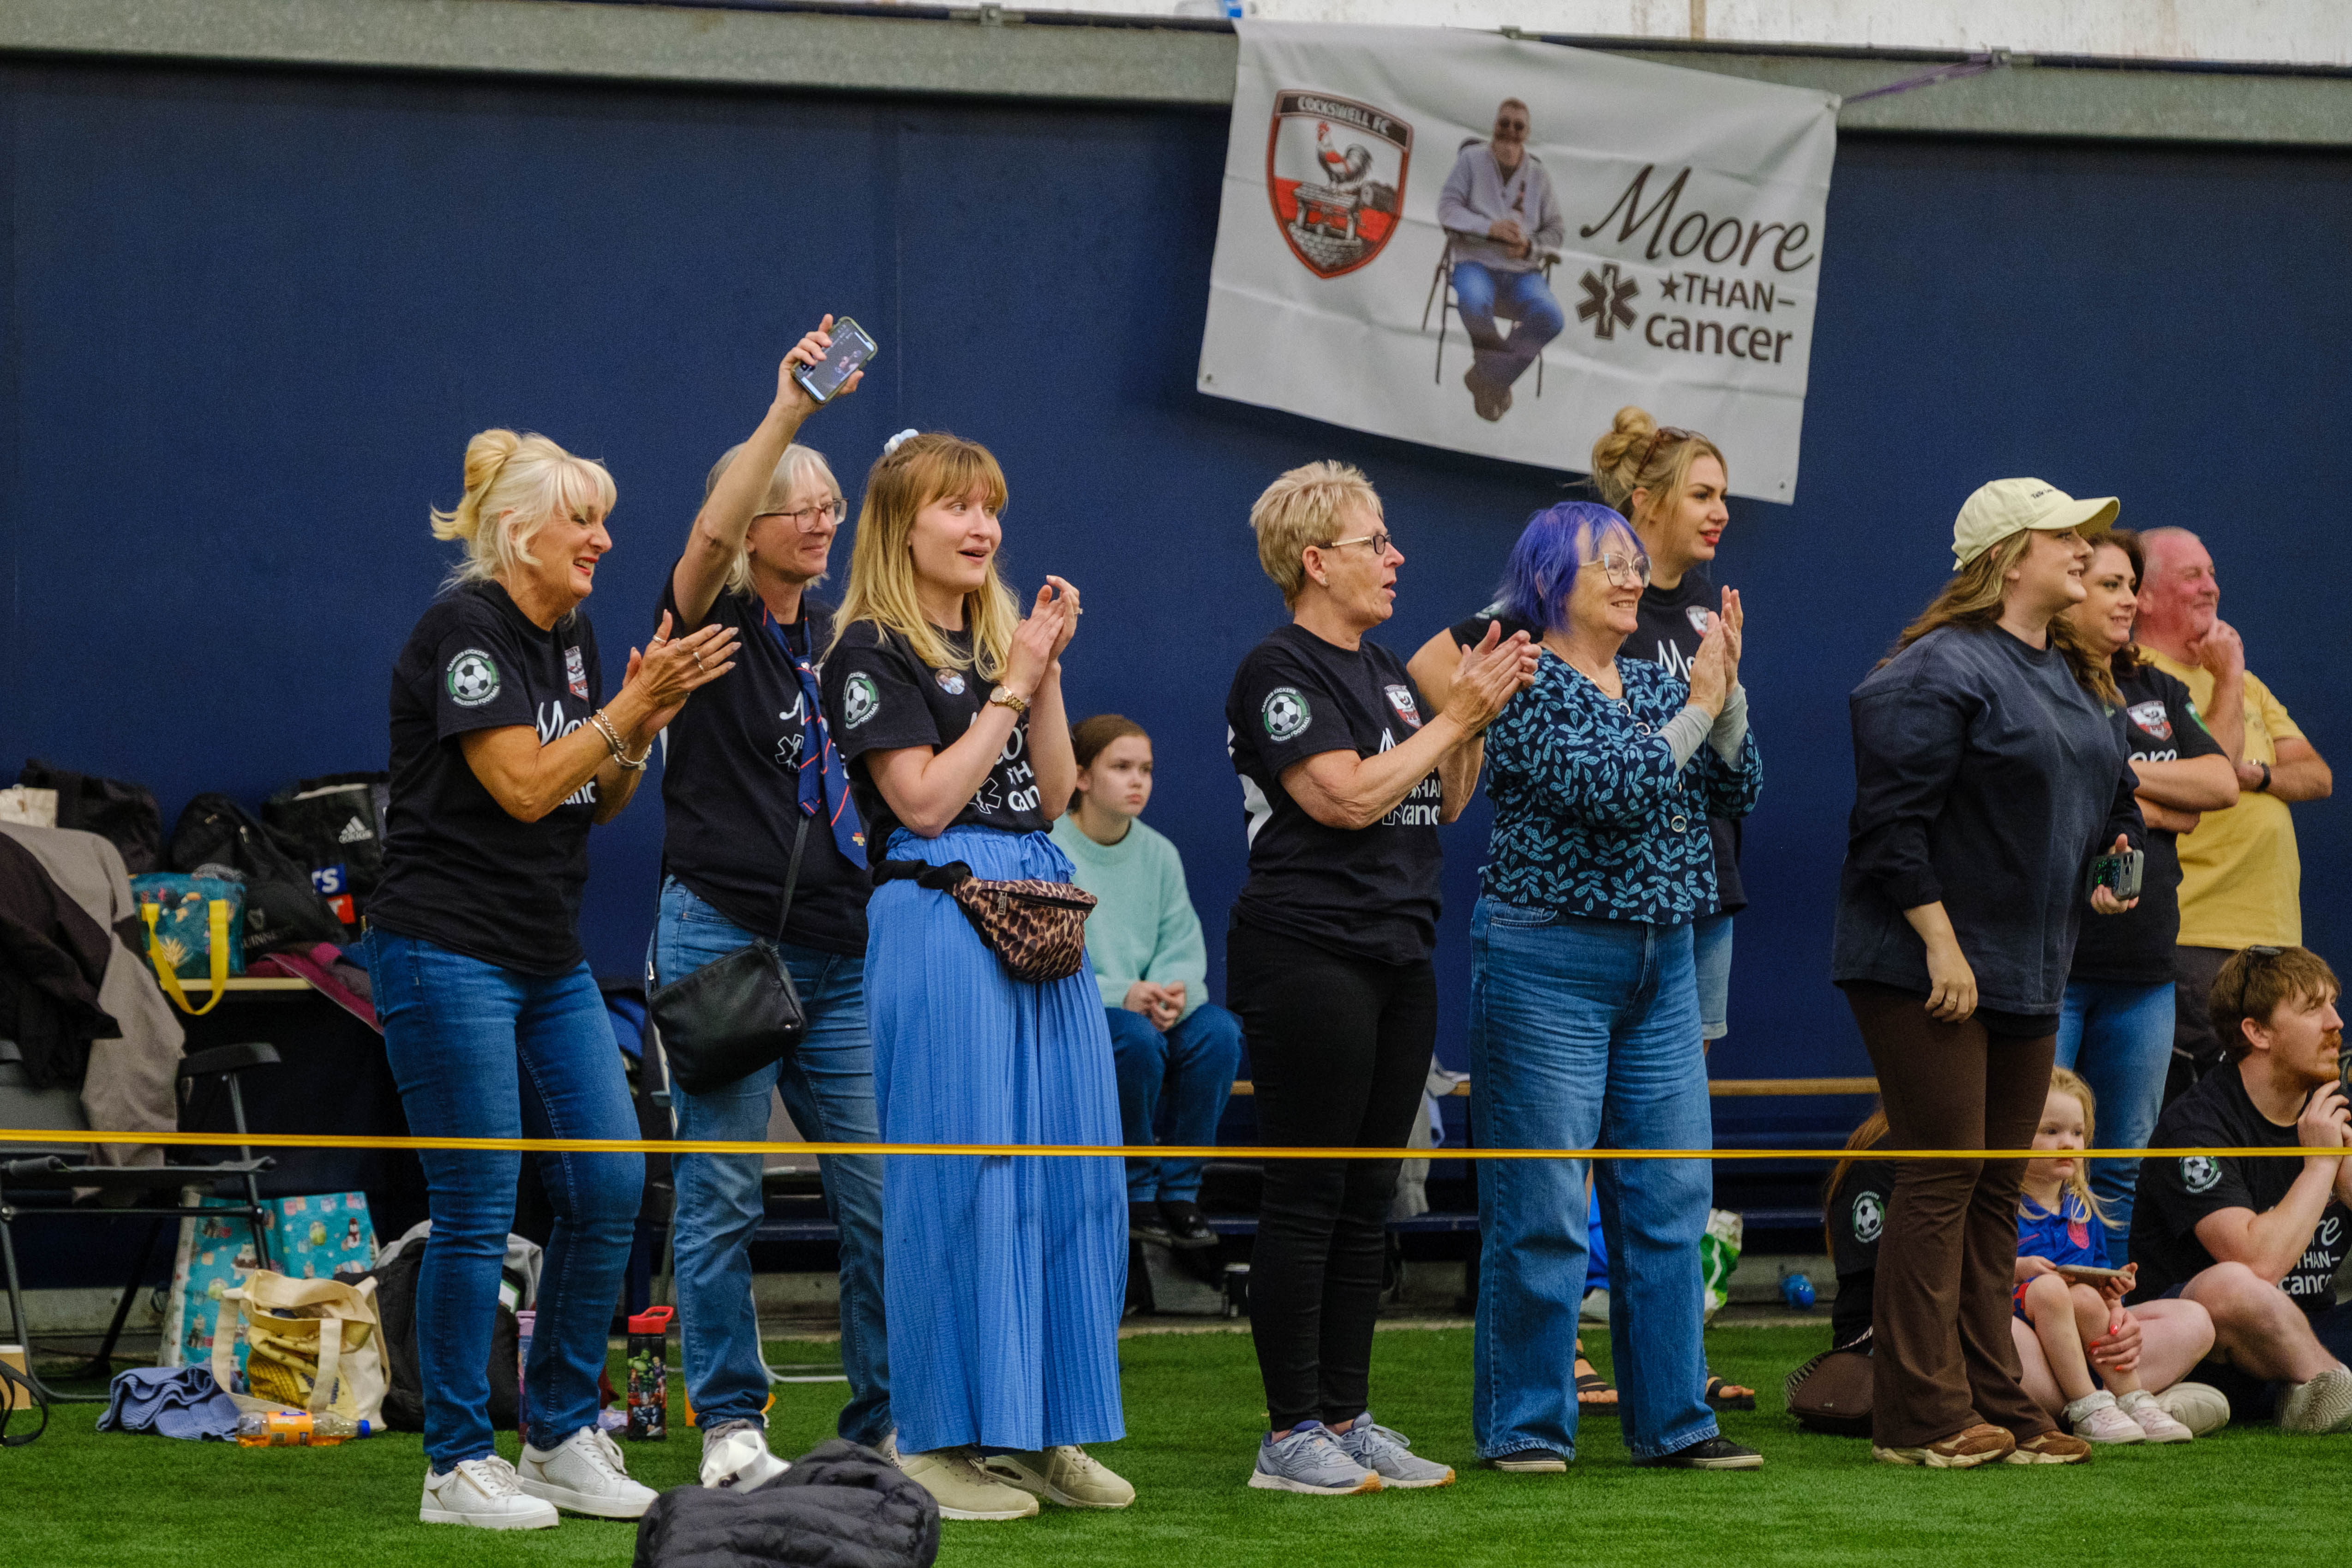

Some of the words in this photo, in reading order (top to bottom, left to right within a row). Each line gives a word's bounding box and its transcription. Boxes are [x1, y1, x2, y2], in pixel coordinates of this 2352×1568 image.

[1372, 116, 1392, 136] FC
[1580, 164, 1815, 272] Moore
[1645, 312, 1793, 363] cancer
[464, 649, 489, 659] KICKERS
[1290, 716, 1311, 736] FOOTBALL
